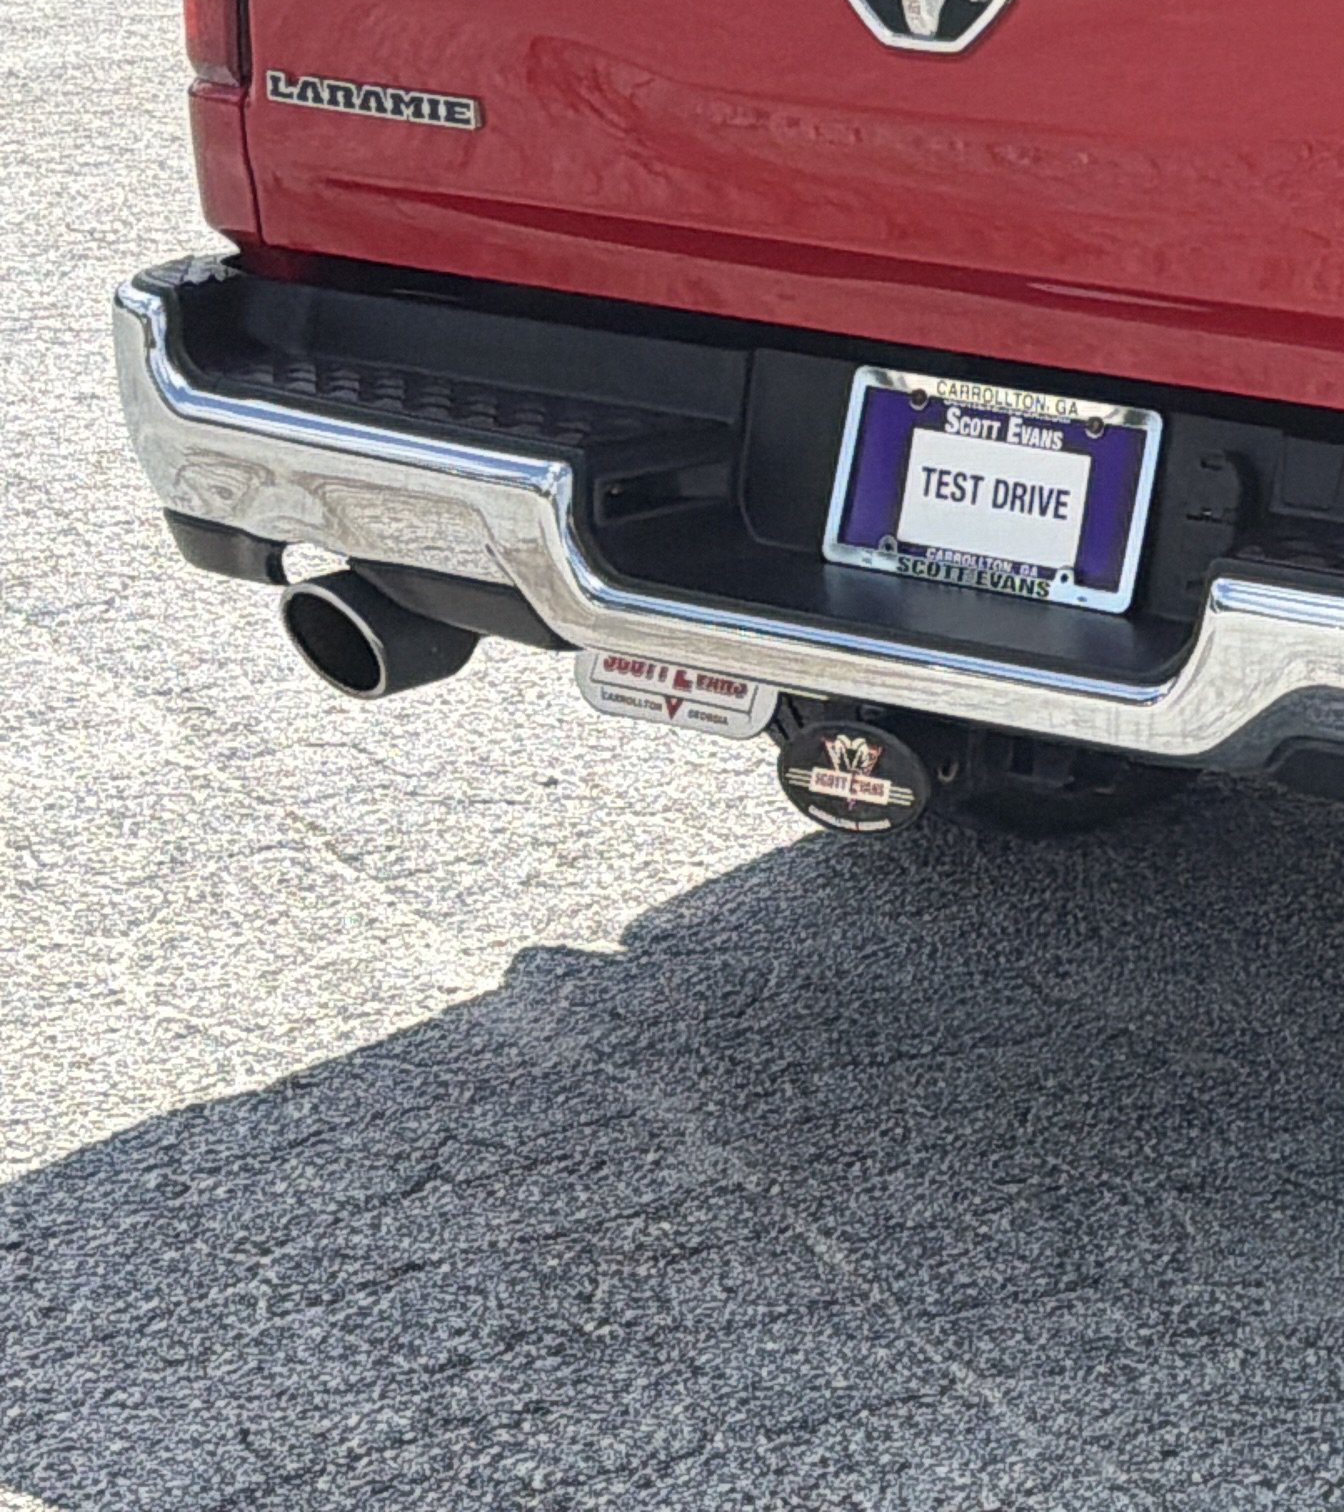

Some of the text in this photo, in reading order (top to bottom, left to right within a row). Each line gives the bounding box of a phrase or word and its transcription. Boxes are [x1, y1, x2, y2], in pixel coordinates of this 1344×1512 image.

[266, 70, 477, 130] LARAMIE
[1055, 399, 1079, 416] GA
[944, 406, 1002, 441] SCOTT
[1006, 415, 1065, 451] EVANS
[921, 465, 1071, 521] TEST DRIVE
[897, 556, 1051, 598] SCOTT EVANS
[1019, 564, 1038, 578] GA
[602, 690, 663, 712] CARROLLTON
[688, 709, 729, 726] GEORGIA
[815, 772, 848, 790] SCOTT
